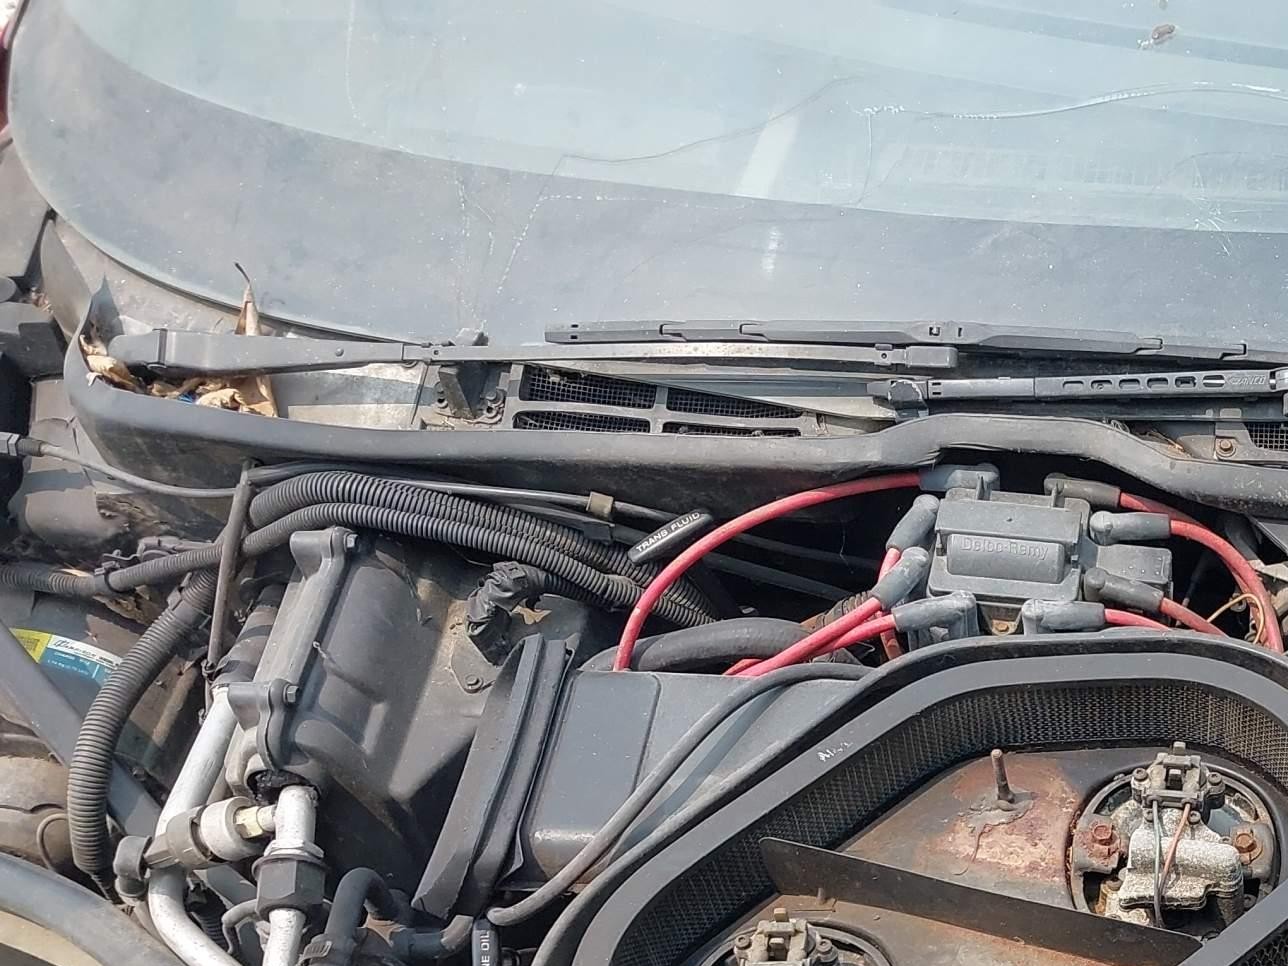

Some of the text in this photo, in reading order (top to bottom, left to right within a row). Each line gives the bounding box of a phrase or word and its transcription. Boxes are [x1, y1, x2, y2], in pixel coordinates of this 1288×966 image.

[635, 511, 701, 553] TRANS FLUID
[480, 930, 491, 951] OIL
